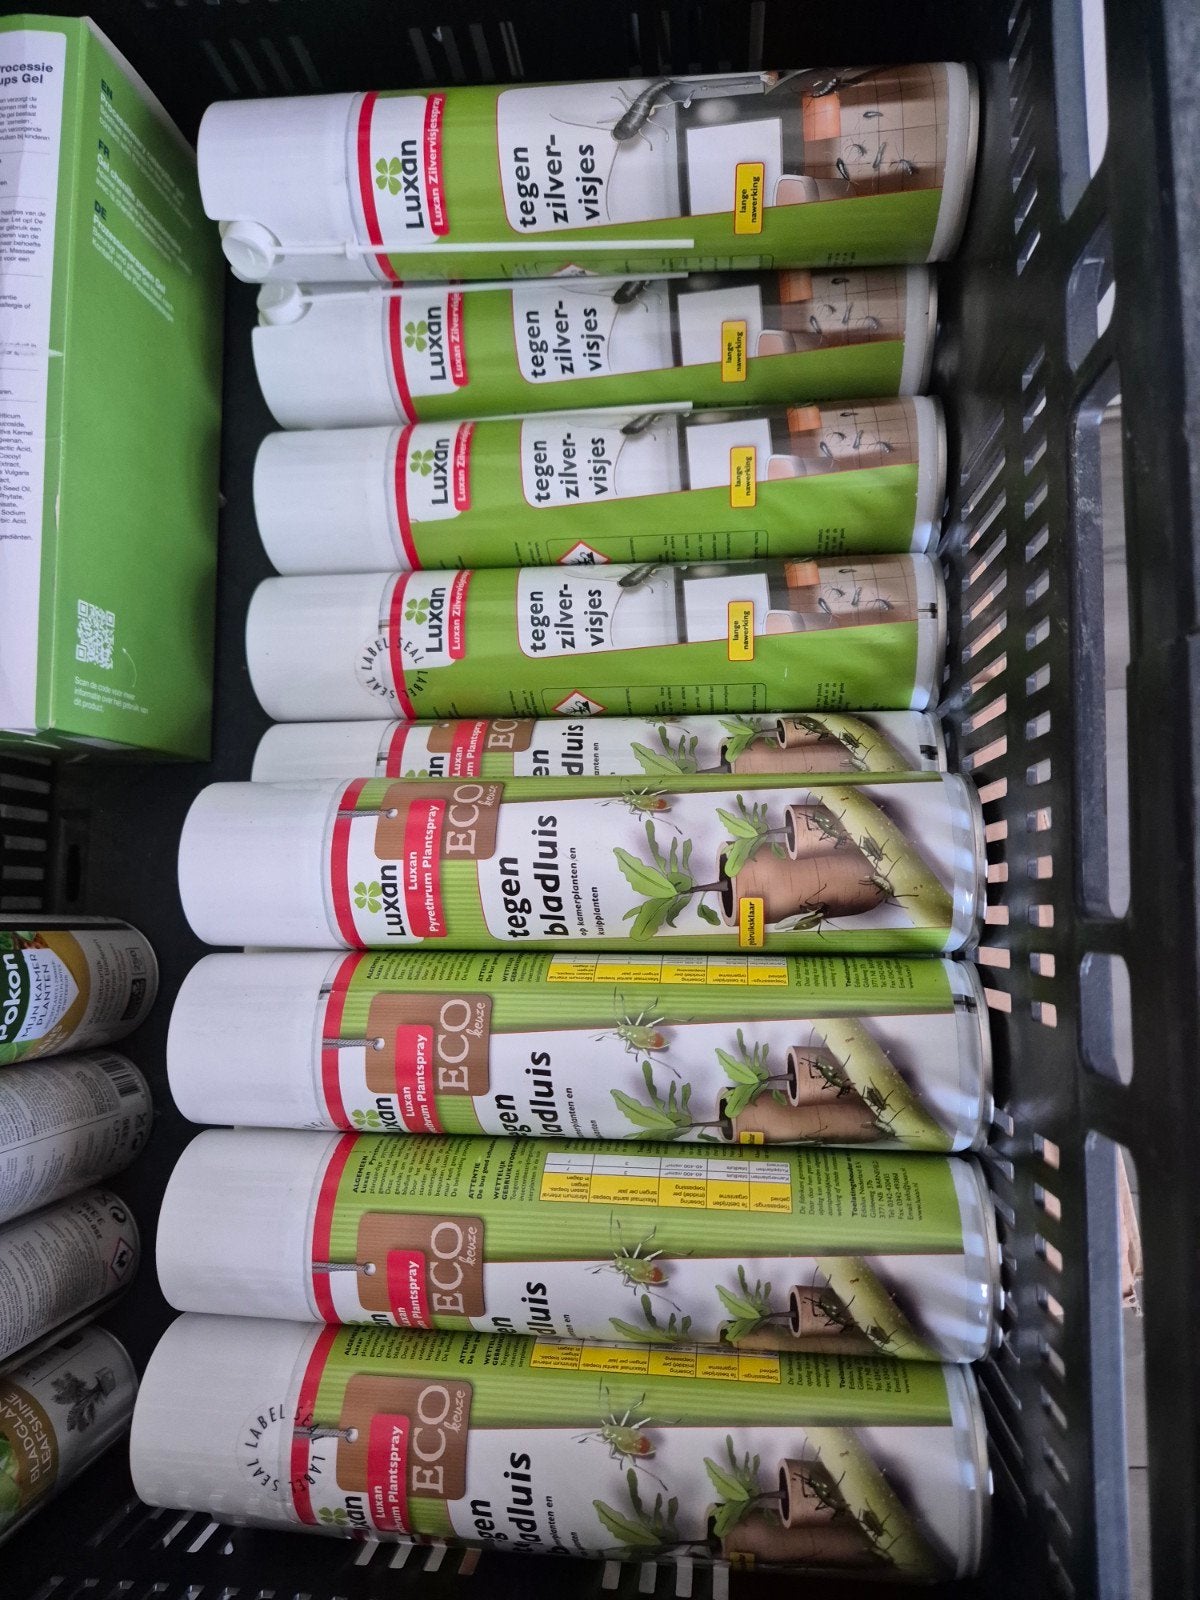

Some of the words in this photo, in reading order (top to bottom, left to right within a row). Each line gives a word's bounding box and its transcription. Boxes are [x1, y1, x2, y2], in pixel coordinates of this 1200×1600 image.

[22, 73, 43, 84] Gel
[100, 76, 113, 102] EN
[97, 136, 110, 161] FR
[427, 96, 443, 185] Zilvervisjesspray
[400, 139, 425, 230] Luxan
[512, 146, 539, 228] tegen
[543, 134, 569, 224] zilver-
[575, 143, 604, 221] visjes
[750, 175, 760, 224] nawerking
[93, 198, 107, 221] DE
[430, 187, 444, 227] Luxan
[739, 188, 749, 214] lange
[426, 306, 447, 381] Luxan
[525, 310, 548, 379] tegen
[552, 300, 575, 375] zilver-
[582, 308, 605, 372] visjes
[725, 341, 734, 364] lange
[735, 331, 743, 373] nawerking
[452, 344, 465, 378] Luxan
[431, 438, 451, 505] Luxan
[457, 469, 467, 502] Luxan
[532, 440, 554, 503] tegen
[557, 432, 580, 499] zilver-
[588, 437, 612, 496] visjes
[734, 465, 743, 487] lange
[744, 456, 753, 497] nawerking
[424, 587, 447, 654] Luxan
[451, 618, 461, 650] Luxan
[528, 591, 550, 653] tegen
[554, 583, 576, 650] zilver-
[583, 588, 609, 647] visjes
[732, 620, 740, 641] lange
[741, 610, 750, 650] nawerking
[361, 637, 390, 671] LABEL
[365, 677, 395, 699] SEAL
[466, 721, 484, 759] Plantspray
[561, 724, 584, 777] dluis
[593, 742, 599, 751] en
[451, 746, 464, 777] Luxan
[422, 804, 439, 868] Plantspray
[445, 783, 485, 855] ECO
[408, 851, 418, 891] Luxan
[568, 846, 578, 860] en
[497, 856, 532, 938] tegen
[531, 815, 569, 937] bladluis
[569, 862, 585, 926] kamerplanten
[379, 864, 407, 937] Luxan
[422, 872, 440, 933] Pyrethrum
[589, 886, 606, 936] kuipplanten
[580, 927, 588, 937] op
[748, 901, 757, 946] gebruiksklaar
[0, 953, 22, 1041] Pokon
[29, 953, 42, 1001] KAMER
[37, 964, 51, 1026] PLANTEN
[21, 1005, 41, 1038] MIJN
[465, 1002, 486, 1038] keuze
[437, 998, 472, 1091] ECO
[415, 1034, 428, 1102] Plantspray
[402, 1086, 415, 1117] Luxan
[524, 1051, 566, 1137] ladluis
[565, 1087, 573, 1099] en
[352, 1155, 369, 1193] ALGEMEEN
[360, 1171, 371, 1194] Luxan
[468, 1162, 481, 1200] ATTENTIE
[478, 1175, 486, 1187] bus
[482, 1159, 490, 1174] goed
[493, 1160, 506, 1200] WETTELIJK
[409, 1180, 418, 1196] Door
[451, 1188, 457, 1198] De
[476, 1189, 483, 1200] De
[680, 1198, 705, 1206] Dosering
[460, 1226, 478, 1264] keuze
[430, 1221, 465, 1313] ECO
[408, 1260, 423, 1319] Plantspray
[521, 1281, 557, 1335] dluis
[563, 1314, 571, 1323] en
[467, 1355, 475, 1364] De
[244, 1403, 285, 1448] LABEL
[443, 1389, 466, 1433] keuze
[6, 1392, 53, 1474] LEAFSHINE
[412, 1385, 450, 1494] ECO
[246, 1458, 280, 1492] SEAL
[387, 1426, 404, 1503] Plantspray
[373, 1485, 386, 1519] Luxan
[470, 1499, 509, 1542] gen
[545, 1495, 554, 1508] en
